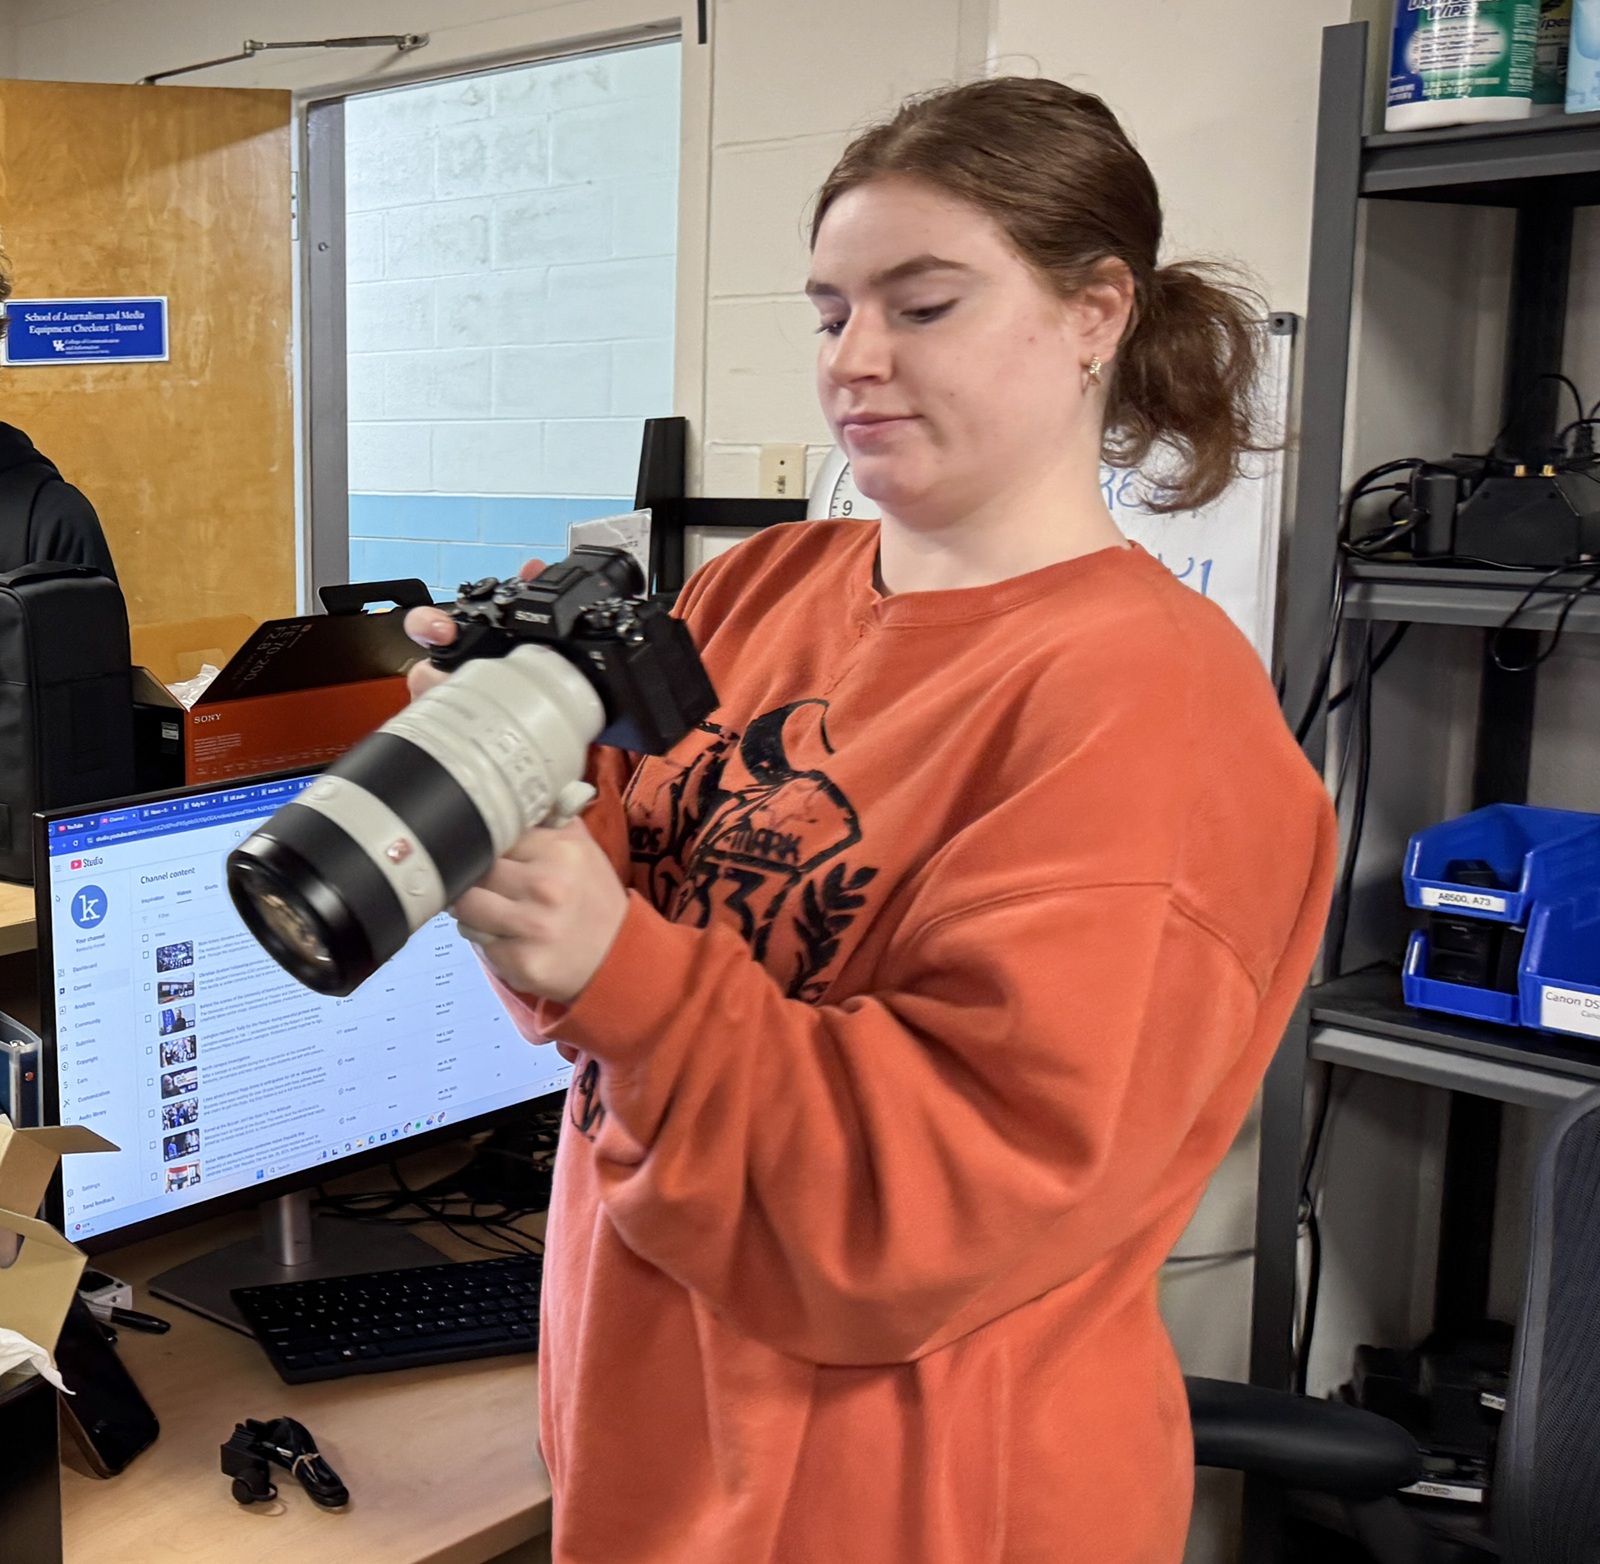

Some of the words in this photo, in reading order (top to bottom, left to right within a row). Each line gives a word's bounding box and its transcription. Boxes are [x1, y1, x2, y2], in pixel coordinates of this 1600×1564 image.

[25, 313, 51, 322] School
[52, 312, 62, 320] of
[62, 311, 104, 320] Journalism
[106, 311, 119, 320] and
[121, 310, 145, 319] Media
[29, 325, 72, 335] Equipment
[72, 324, 110, 332] Checkout
[115, 324, 137, 332] Room
[842, 500, 852, 516] 9
[194, 714, 221, 724] SONY
[83, 856, 103, 868] Studio
[140, 872, 168, 884] Channel
[169, 868, 195, 879] content
[1473, 897, 1491, 906] A73
[80, 895, 100, 922] k
[87, 934, 105, 943] channel
[74, 983, 92, 991] Content
[1545, 991, 1581, 1006] Canon
[74, 1001, 95, 1010] Analytics
[75, 1018, 101, 1028] Community
